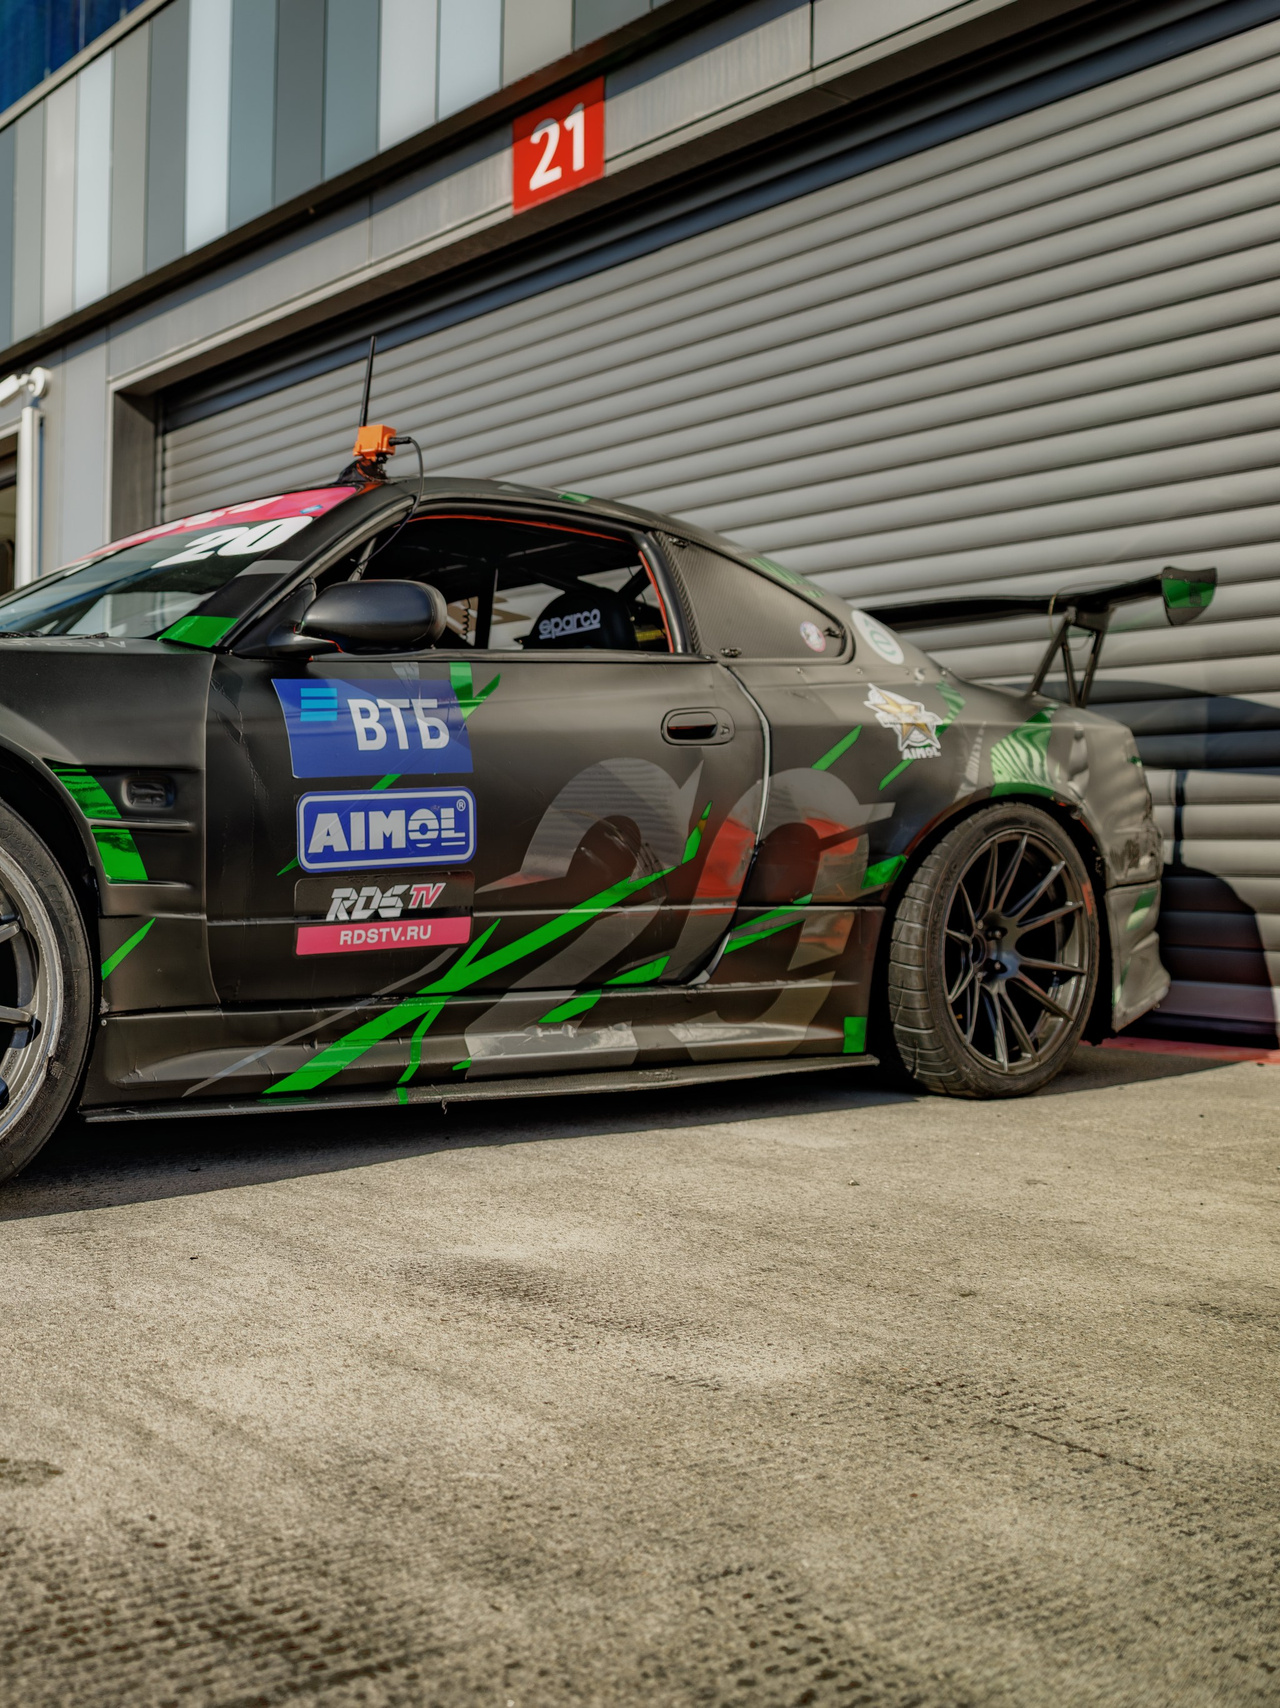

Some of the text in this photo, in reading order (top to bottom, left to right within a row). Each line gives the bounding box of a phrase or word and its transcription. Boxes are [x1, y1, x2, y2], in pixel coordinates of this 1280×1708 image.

[529, 102, 585, 191] 21
[151, 516, 313, 570] 20
[347, 699, 449, 750] ВТБ
[339, 925, 432, 945] RDSTV.RU
